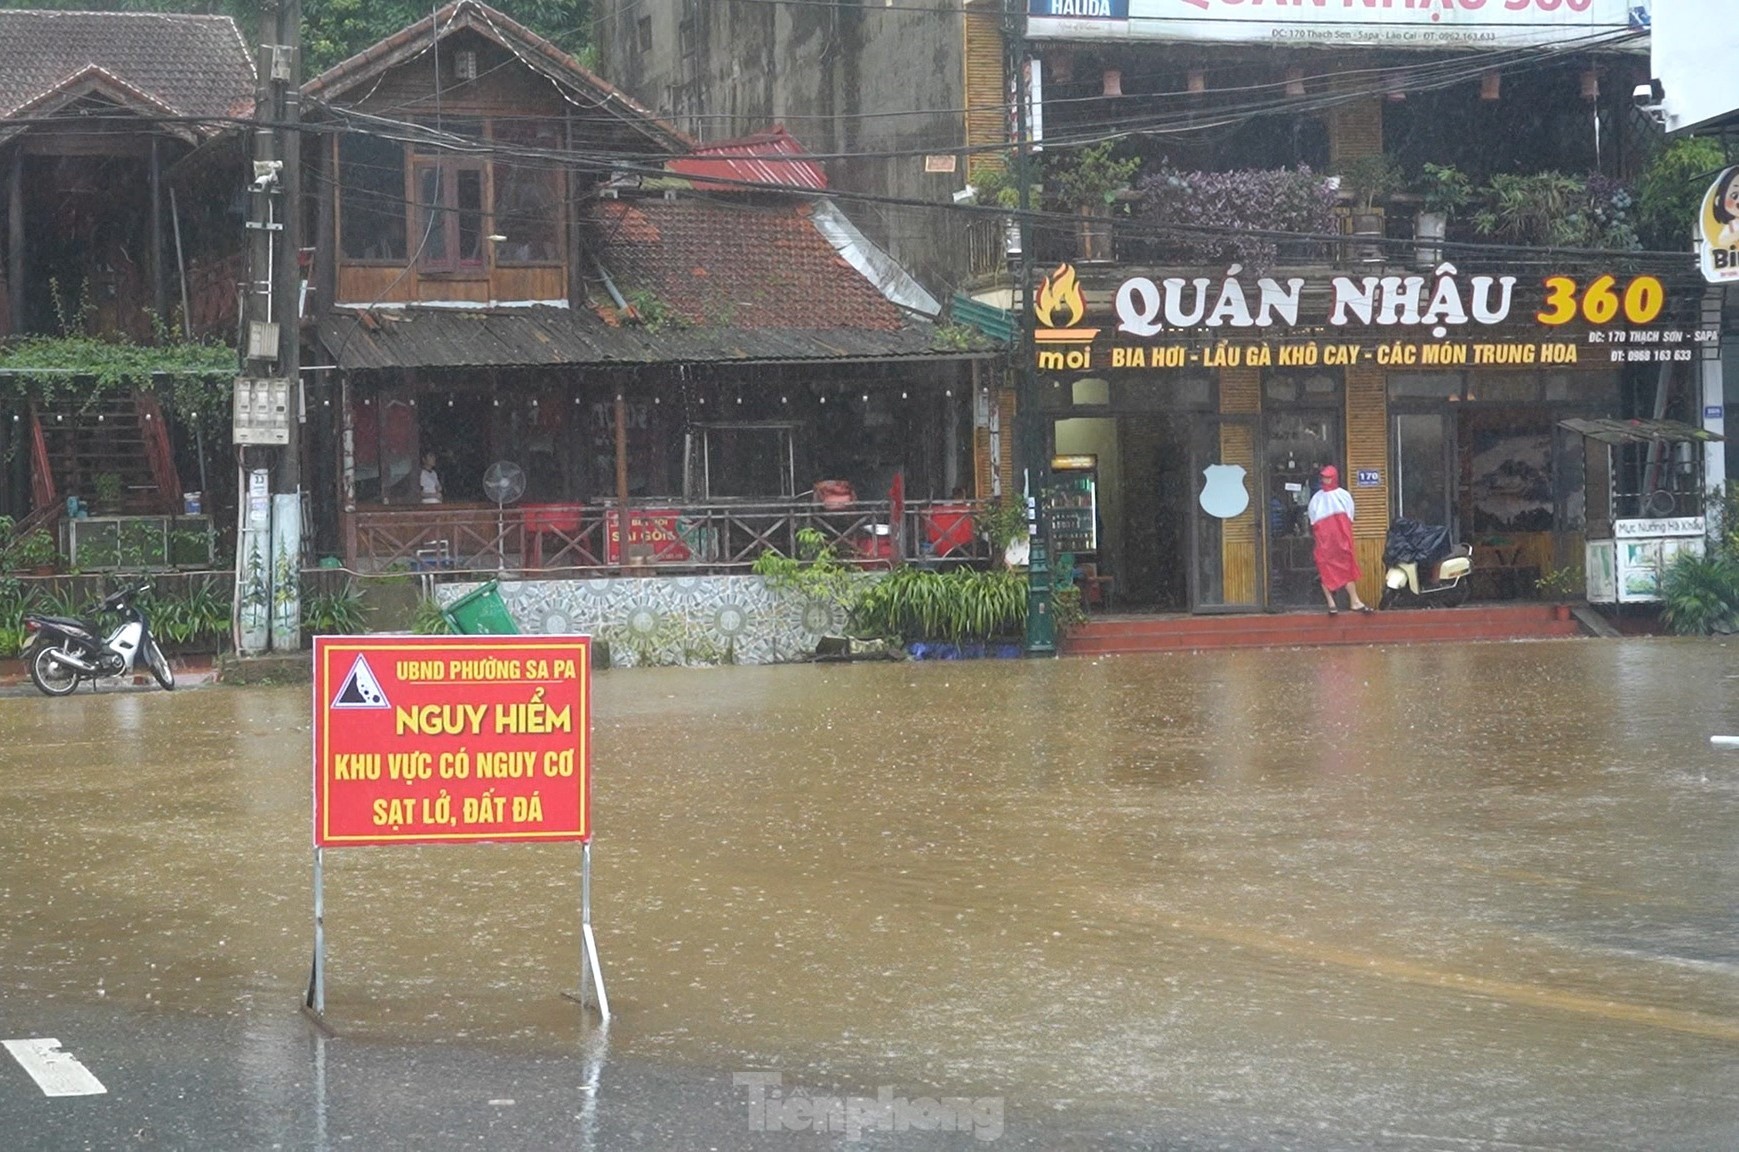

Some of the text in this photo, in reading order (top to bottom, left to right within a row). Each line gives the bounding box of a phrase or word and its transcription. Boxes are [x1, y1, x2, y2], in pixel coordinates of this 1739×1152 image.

[1051, 0, 1112, 16] HALIDA
[1289, 29, 1305, 38] 170
[1712, 245, 1739, 269] Bi
[1115, 262, 1664, 338] QUÁN NHẬU 360
[1608, 331, 1626, 343] 170
[1630, 331, 1660, 345] THẠCH
[1694, 330, 1718, 342] SAPA
[1038, 346, 1091, 370] moi
[1112, 347, 1146, 368] BIA
[1152, 344, 1186, 367] HƠI
[1246, 341, 1272, 367] GÀ
[1278, 342, 1318, 366] KHÔ
[1324, 345, 1360, 365] CAY
[1377, 341, 1416, 365] CÁC
[1421, 341, 1466, 364] MÓN
[1473, 344, 1536, 364] TRUNG
[1541, 344, 1577, 363] HOA
[1654, 350, 1671, 362] 163
[1673, 350, 1692, 361] 633
[1360, 472, 1379, 481] 170
[396, 656, 576, 680] UBND PHƯỜNG SA PA
[396, 686, 572, 736] NGUY HIỂM
[335, 747, 575, 785] KHU VỰC CÓ NGUY CƠ
[373, 788, 543, 830] SẠT LỞ, ĐẤT ĐÁ
